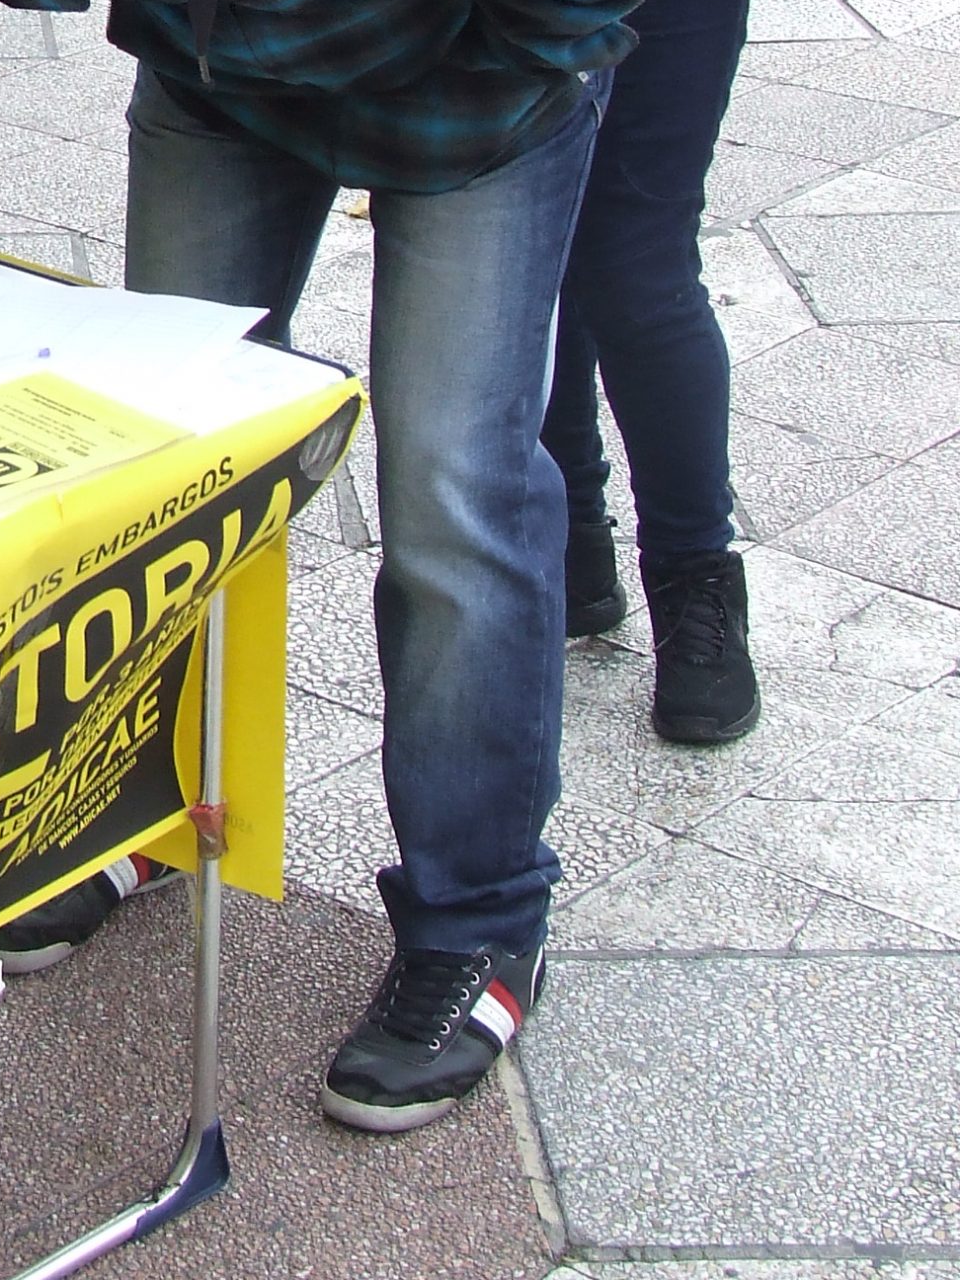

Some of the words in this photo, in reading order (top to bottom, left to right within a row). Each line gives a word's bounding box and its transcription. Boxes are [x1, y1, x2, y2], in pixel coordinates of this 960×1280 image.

[75, 456, 234, 576] EMBARGOS
[2, 765, 57, 819] POR
[57, 781, 122, 852] WWW.ADICAE.NET
[77, 788, 101, 818] CAJAS
[104, 753, 138, 792] SEGUROS
